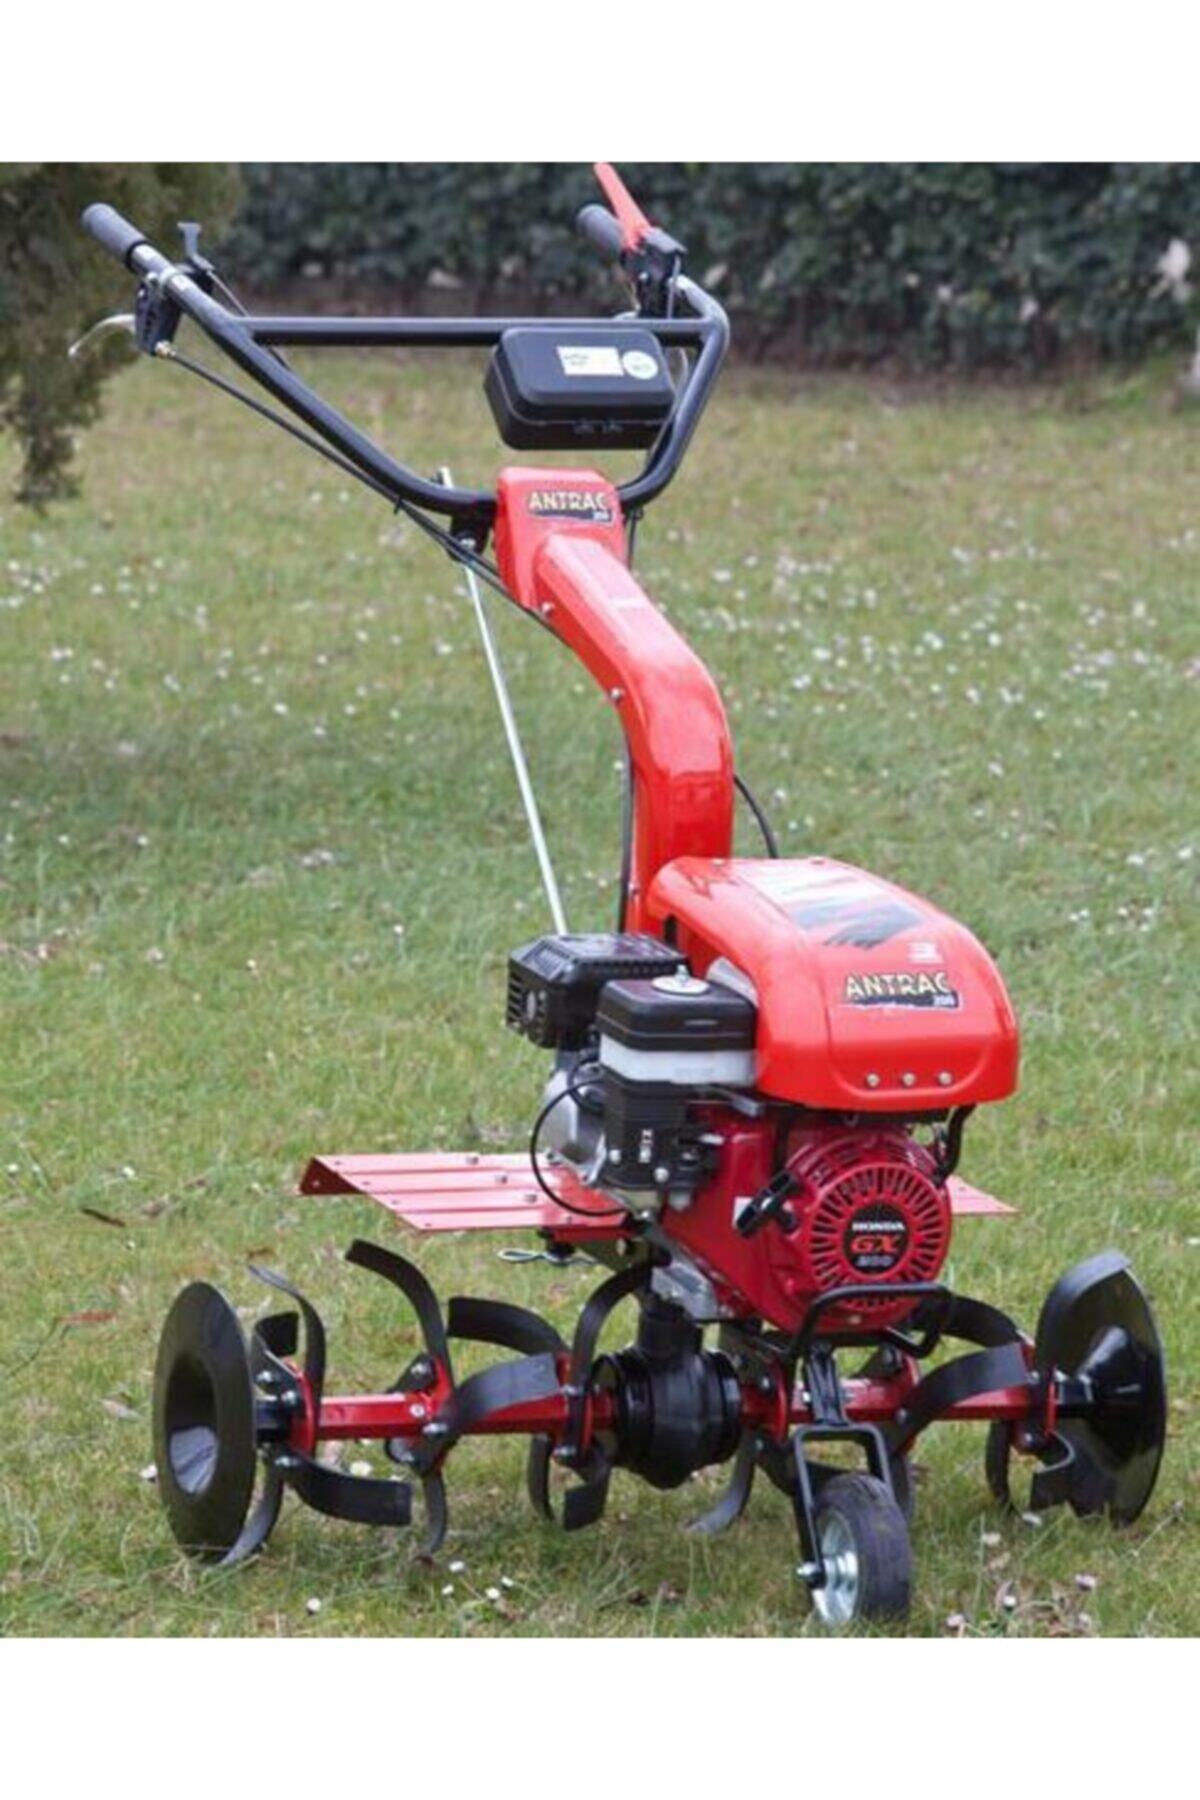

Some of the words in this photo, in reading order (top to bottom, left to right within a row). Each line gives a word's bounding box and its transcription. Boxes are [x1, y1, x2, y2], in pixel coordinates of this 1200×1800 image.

[528, 490, 608, 512] ANTRAC
[845, 970, 951, 998] ANTRAC
[851, 1221, 906, 1232] HONDA
[851, 1234, 902, 1253] GX
